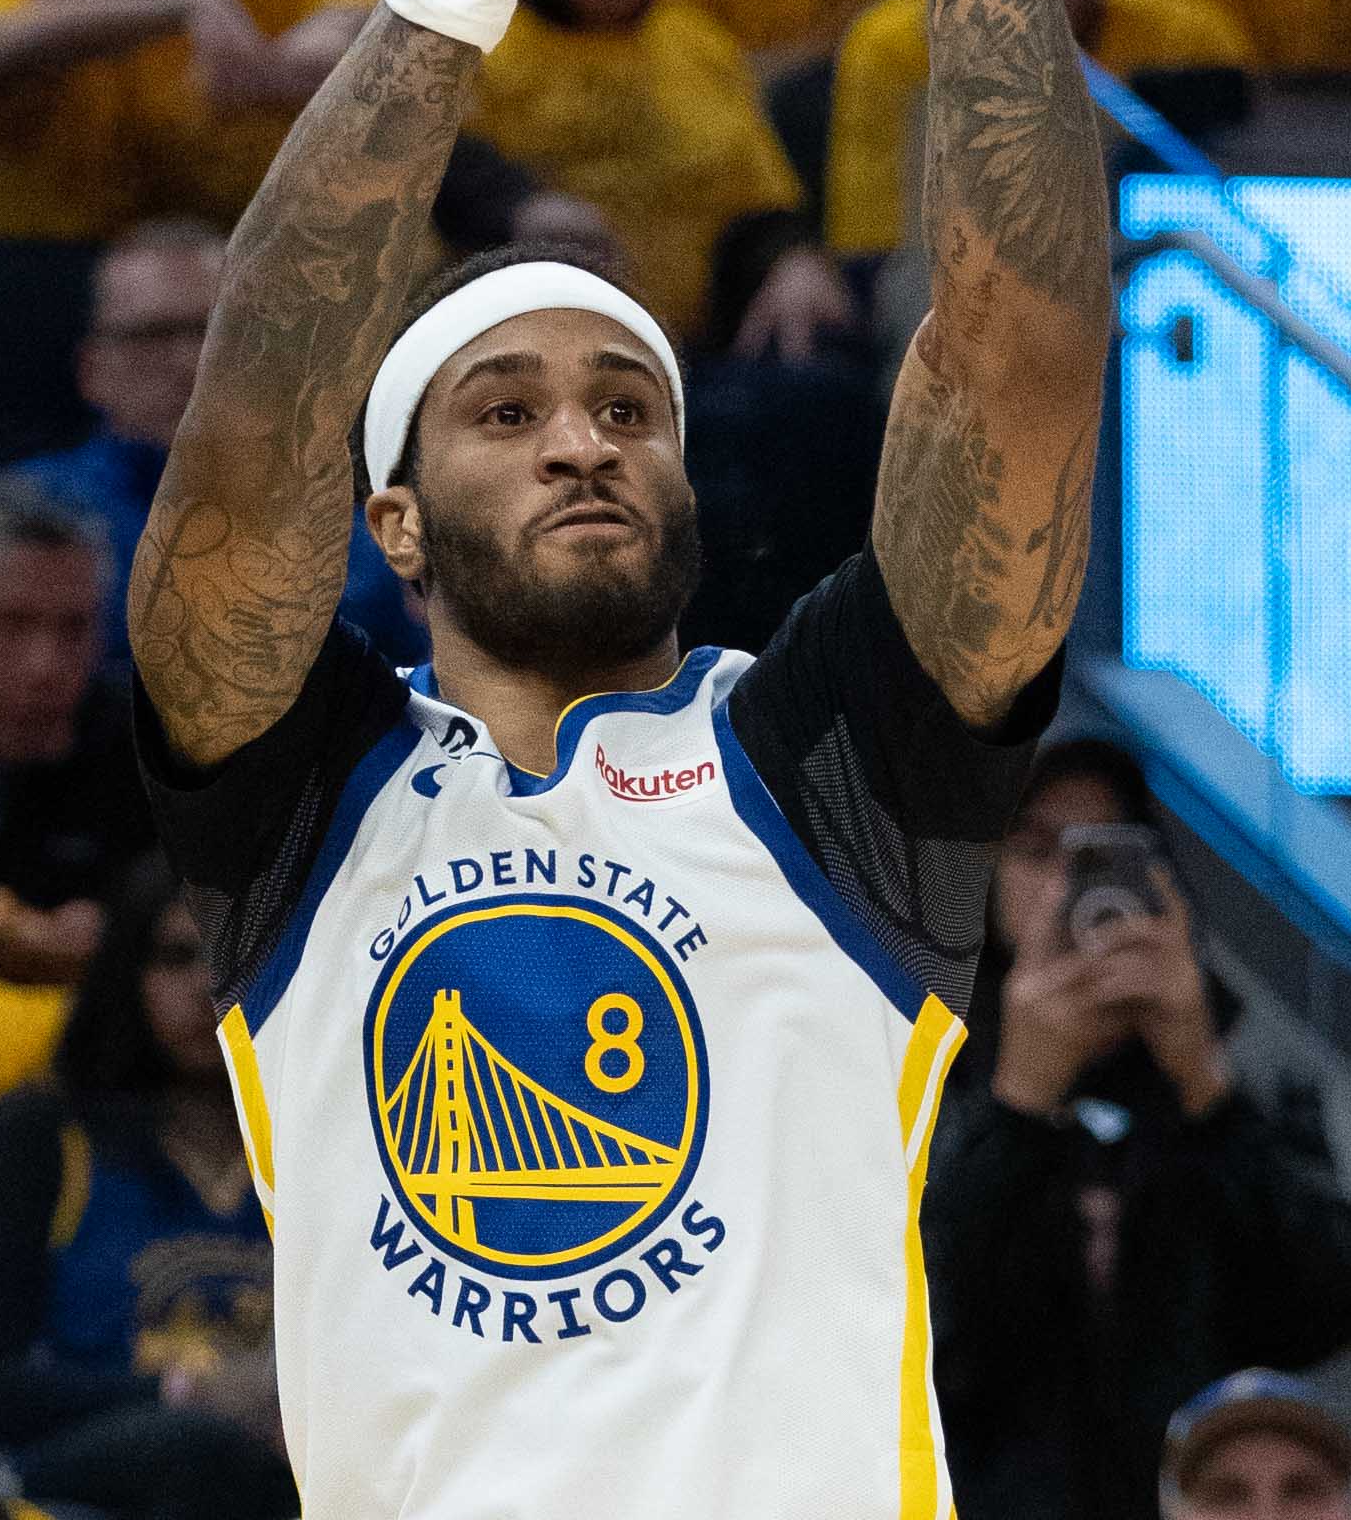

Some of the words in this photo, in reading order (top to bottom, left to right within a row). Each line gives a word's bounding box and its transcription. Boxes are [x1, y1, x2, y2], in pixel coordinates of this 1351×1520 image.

[594, 742, 716, 797] Rakuten
[369, 848, 558, 964] GOLDEN
[577, 854, 711, 964] STATE
[584, 992, 645, 1094] 8
[369, 1194, 727, 1345] WARRIORS
